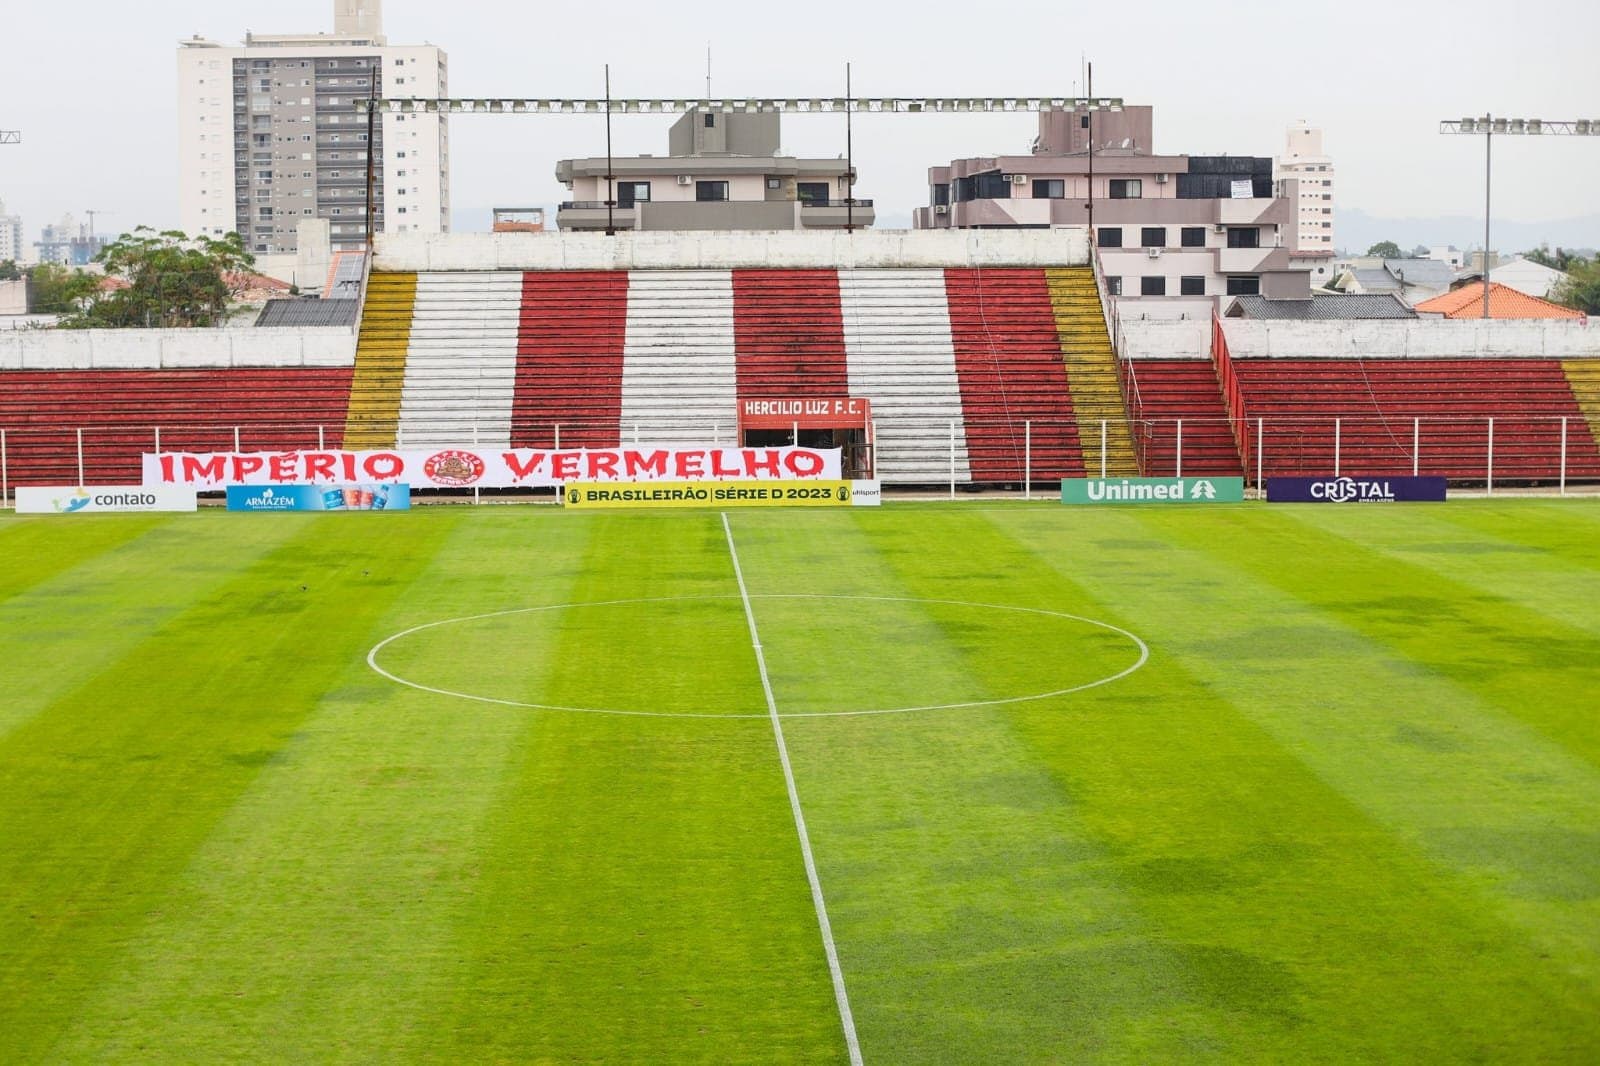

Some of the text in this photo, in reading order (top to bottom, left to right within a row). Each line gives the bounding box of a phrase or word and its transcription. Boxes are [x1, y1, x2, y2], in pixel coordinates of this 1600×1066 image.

[745, 401, 861, 415] HERCILIO LUZ F.C.
[160, 453, 404, 482] IMPÉRIO
[502, 450, 825, 480] VERMELHO
[587, 487, 832, 501] BRASILEIRÃO SÉRIE D 2023
[852, 489, 879, 497] uhlsport
[1087, 480, 1184, 500] Unimed
[1310, 480, 1394, 500] CRISTAL
[95, 493, 156, 506] contato
[245, 496, 294, 506] ARMAZÉM
